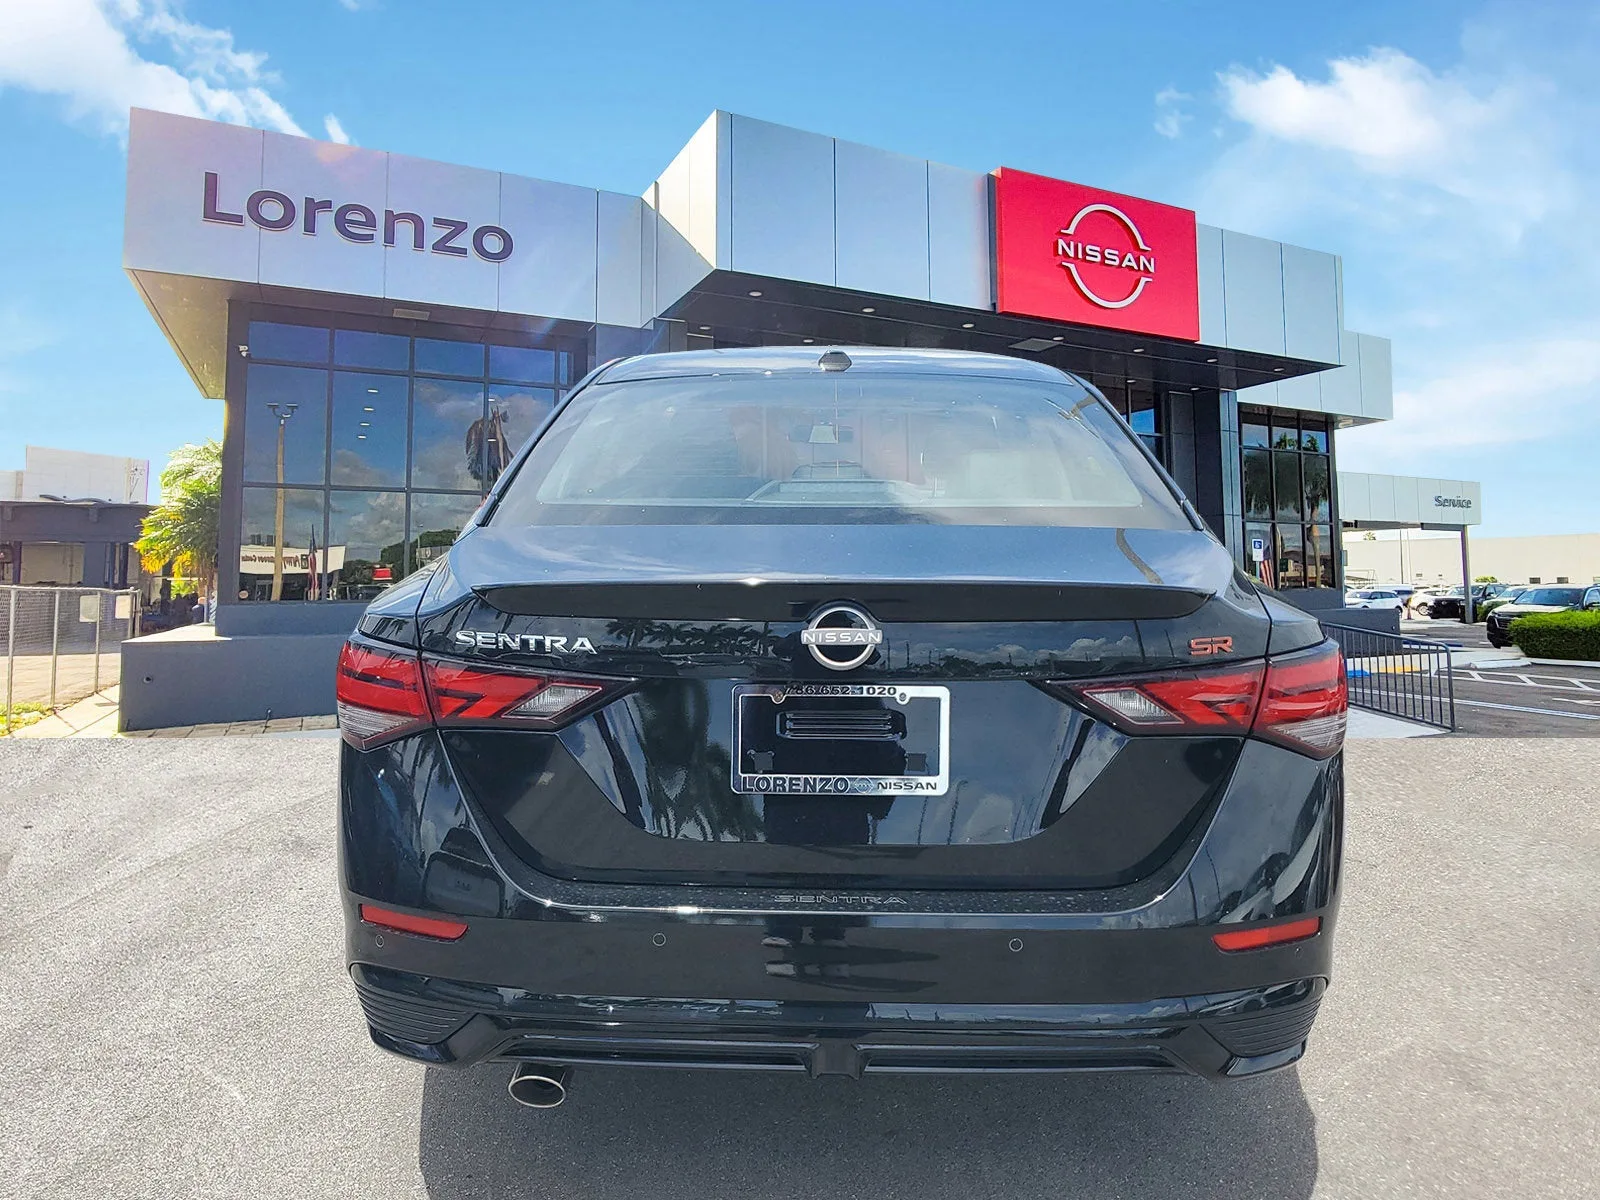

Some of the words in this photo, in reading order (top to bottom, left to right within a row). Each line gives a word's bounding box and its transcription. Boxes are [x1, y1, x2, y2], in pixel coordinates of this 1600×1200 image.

[202, 171, 515, 263] Lorenzo
[1056, 238, 1156, 273] NISSAN
[1434, 495, 1472, 509] Service
[455, 630, 598, 655] SENTRA
[803, 632, 882, 643] NISSAN
[1190, 636, 1234, 656] SR
[742, 776, 850, 794] LORENZO
[876, 780, 938, 791] NISSAN
[773, 894, 908, 904] SENTRA
